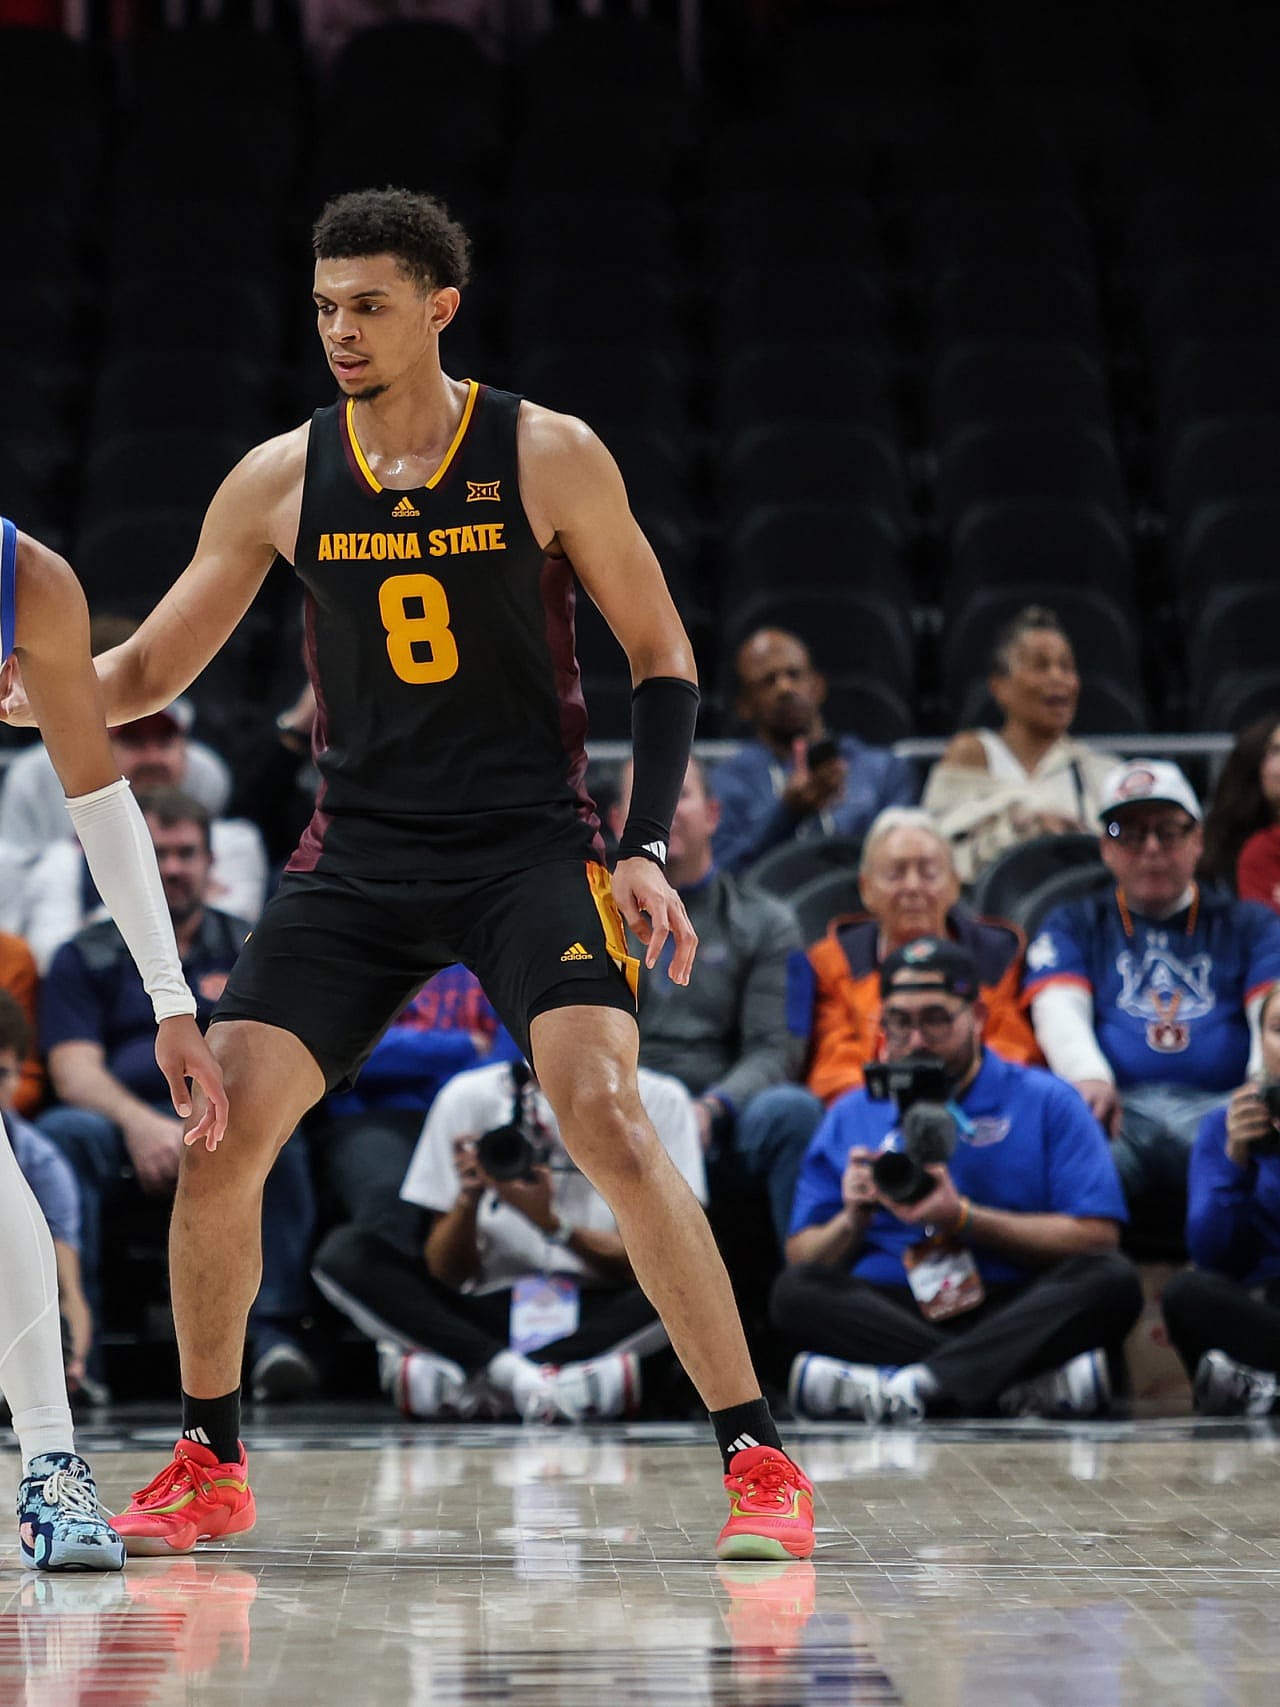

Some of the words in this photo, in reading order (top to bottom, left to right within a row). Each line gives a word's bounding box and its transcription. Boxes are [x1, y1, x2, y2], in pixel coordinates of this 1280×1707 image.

[391, 509, 420, 518] adidas
[318, 532, 422, 561] ARIZONA
[428, 523, 507, 557] STATE
[378, 573, 459, 685] 8
[560, 954, 593, 962] adidas
